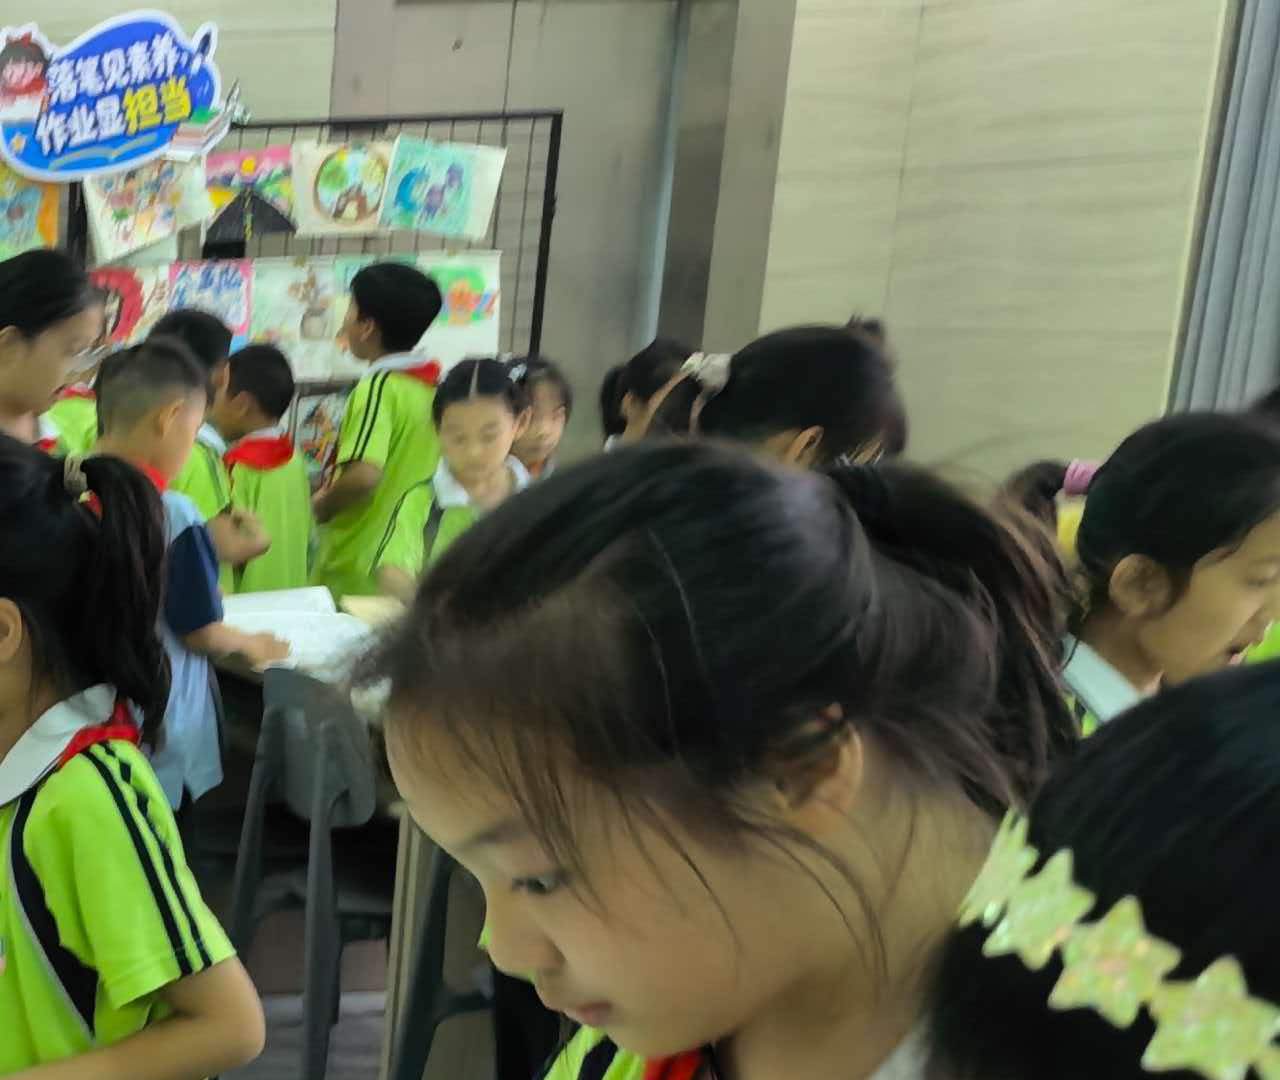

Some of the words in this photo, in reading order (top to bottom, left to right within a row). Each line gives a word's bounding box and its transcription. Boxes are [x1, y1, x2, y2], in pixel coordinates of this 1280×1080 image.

[35, 76, 191, 156] 作业显担当
